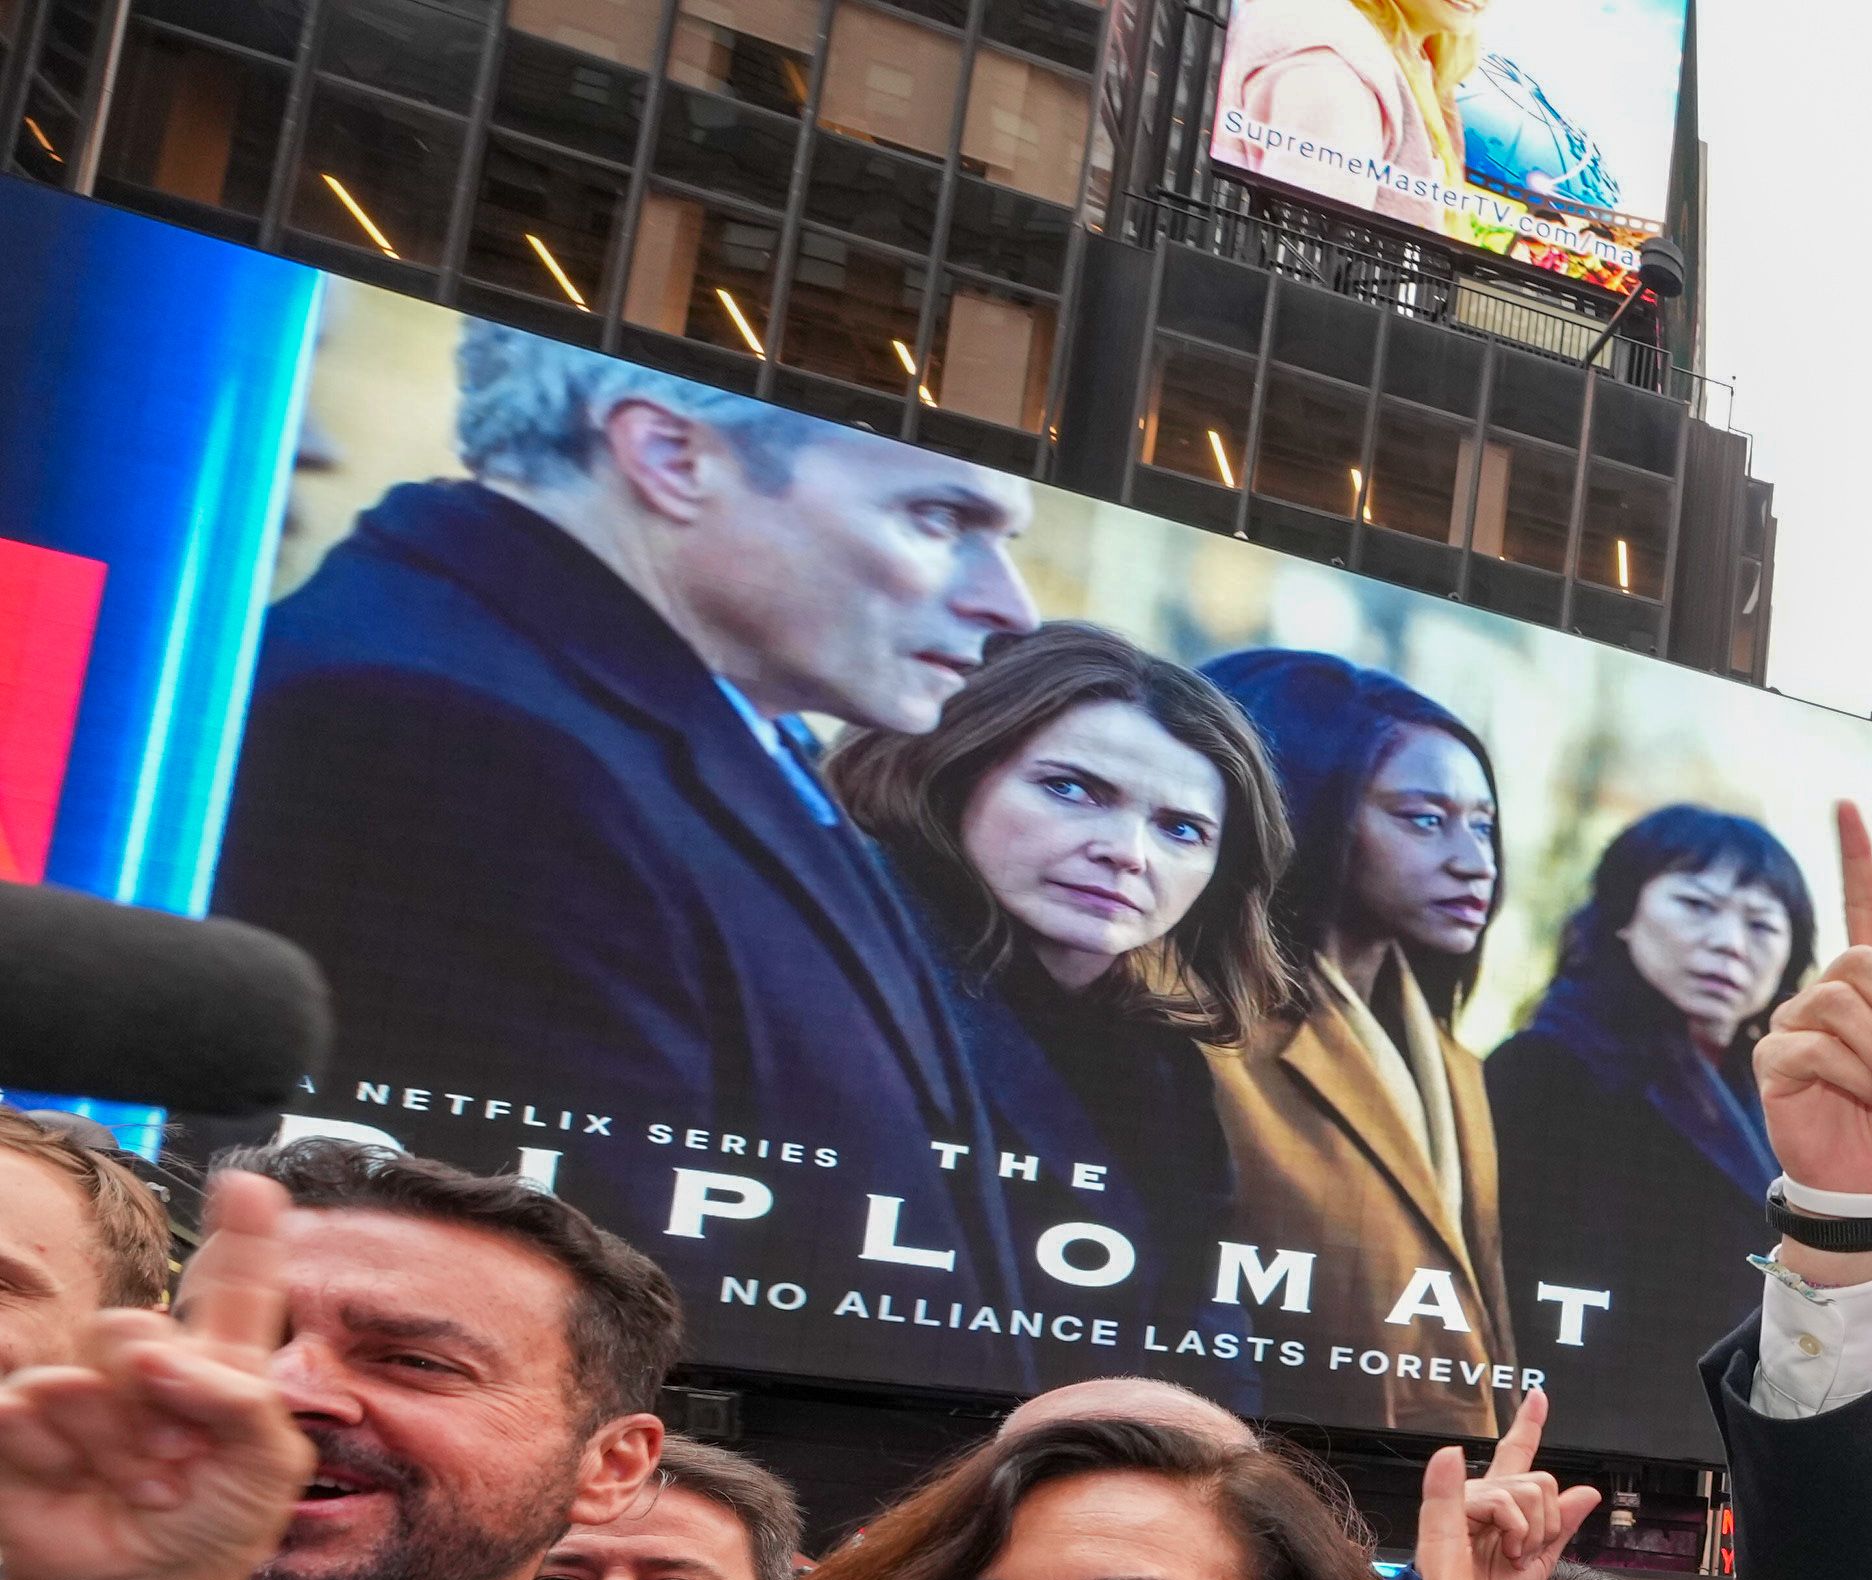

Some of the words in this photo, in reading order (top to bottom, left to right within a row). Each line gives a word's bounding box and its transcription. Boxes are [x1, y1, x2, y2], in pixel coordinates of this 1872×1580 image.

[1224, 110, 1635, 268] SupremeMasterTV.com/ma
[355, 1080, 613, 1137] NETFLIX
[647, 1123, 840, 1168] SERIES
[930, 1140, 1107, 1192] THE
[721, 1276, 806, 1311] NO
[833, 1288, 1119, 1347] ALLIANCE
[1144, 1325, 1306, 1367] LASTS
[1329, 1346, 1546, 1392] FOREVER
